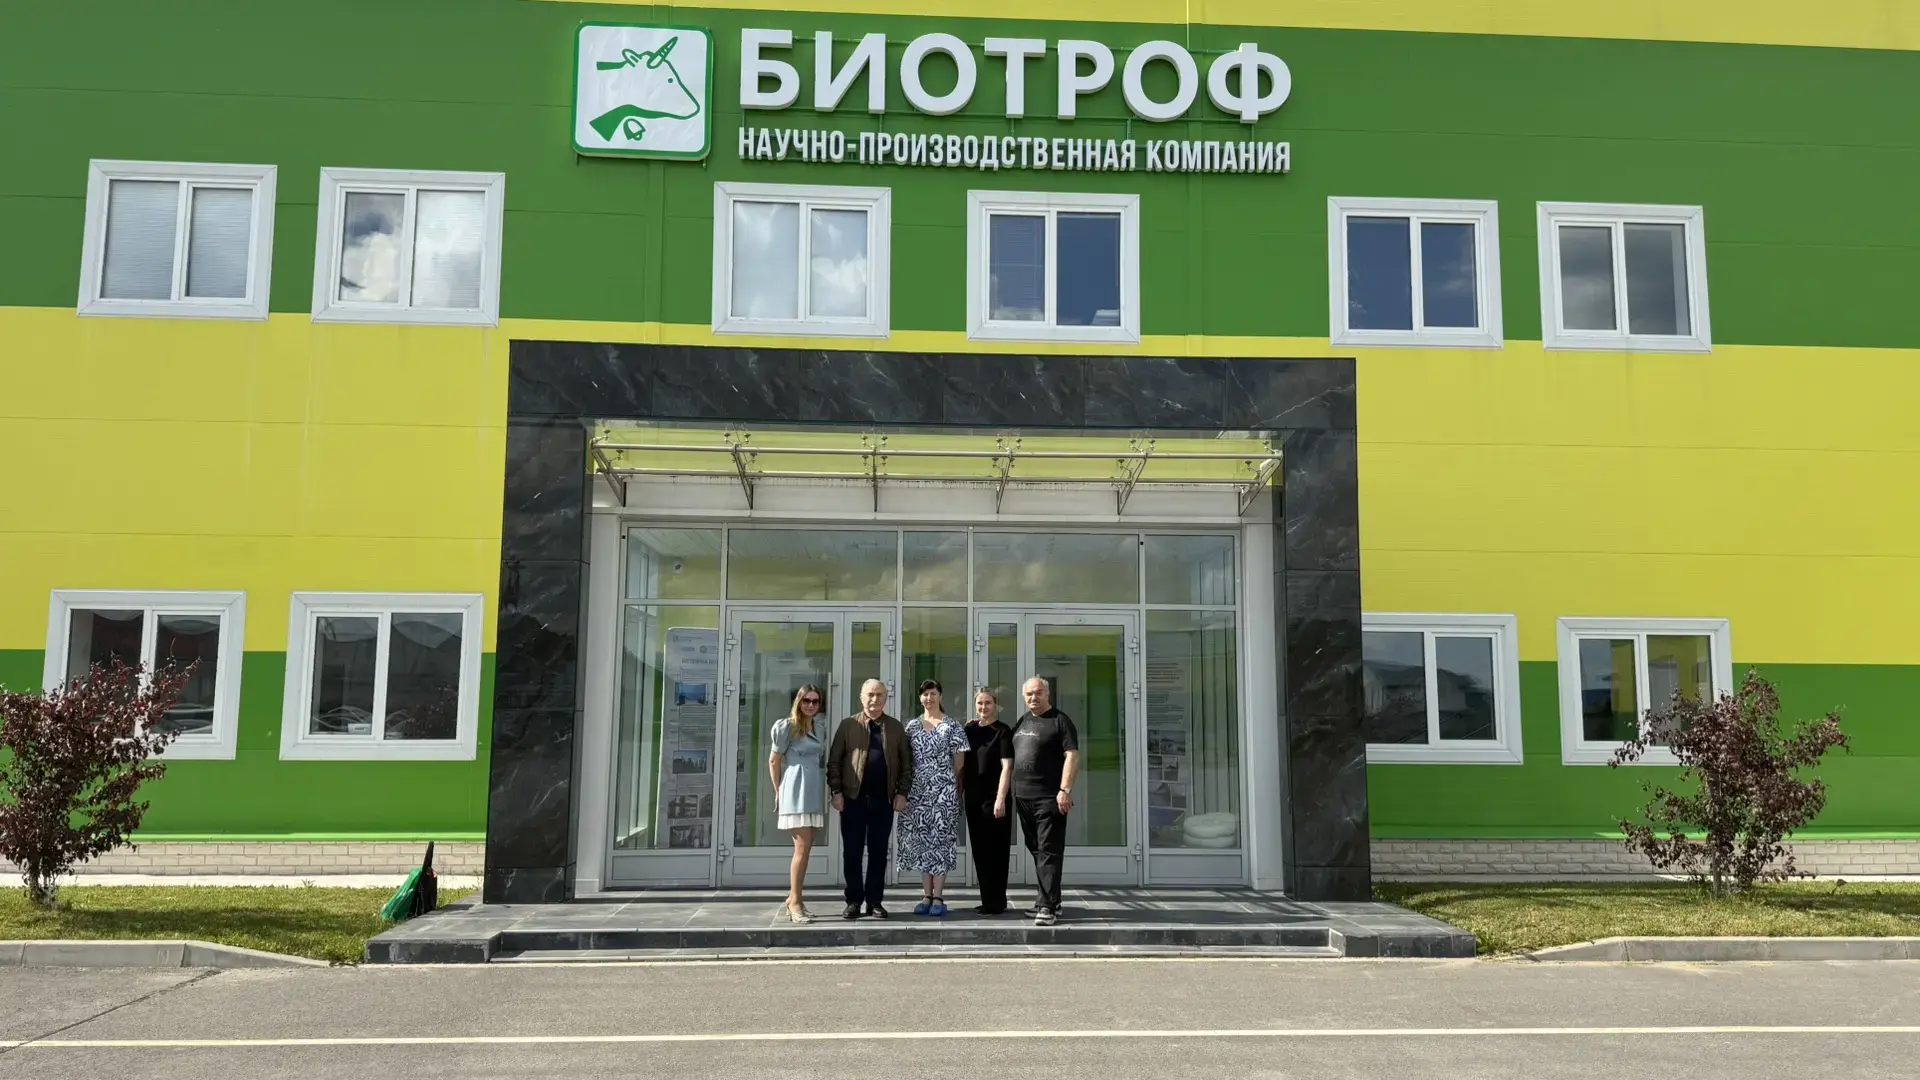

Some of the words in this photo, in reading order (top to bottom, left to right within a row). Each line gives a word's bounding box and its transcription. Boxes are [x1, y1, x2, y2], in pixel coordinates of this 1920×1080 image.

[740, 28, 1292, 124] БИОТРОФ
[738, 126, 1136, 172] НАУЧНО-ПРОИЗВОДСТВЕННАЯ
[1146, 139, 1291, 174] КОМПАНИЯ
